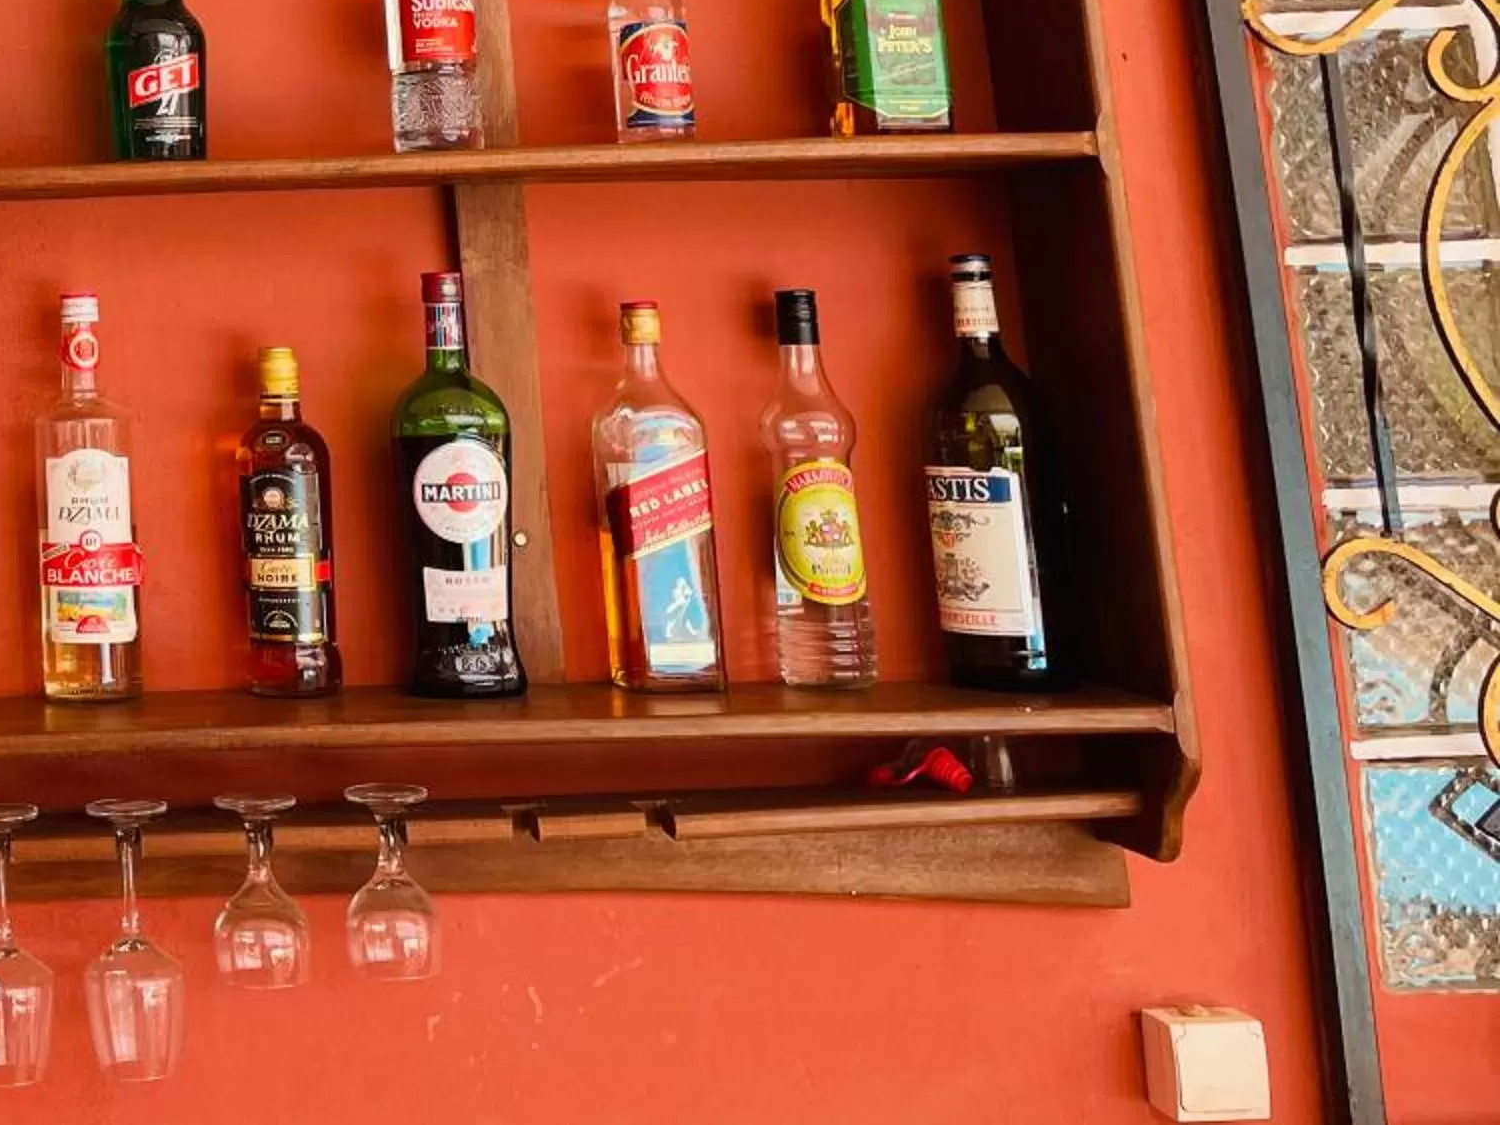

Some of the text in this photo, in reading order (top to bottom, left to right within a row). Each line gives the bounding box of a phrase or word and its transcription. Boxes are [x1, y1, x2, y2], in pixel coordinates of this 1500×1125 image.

[413, 16, 459, 29] VODKA
[135, 60, 197, 96] GET
[423, 482, 500, 502] MARTINI
[629, 497, 661, 519] RED
[663, 478, 709, 505] LABEL
[928, 476, 991, 502] ASTIS
[247, 513, 310, 535] DZAMA
[255, 530, 301, 544] RHUM
[47, 568, 135, 584] BLANCHE
